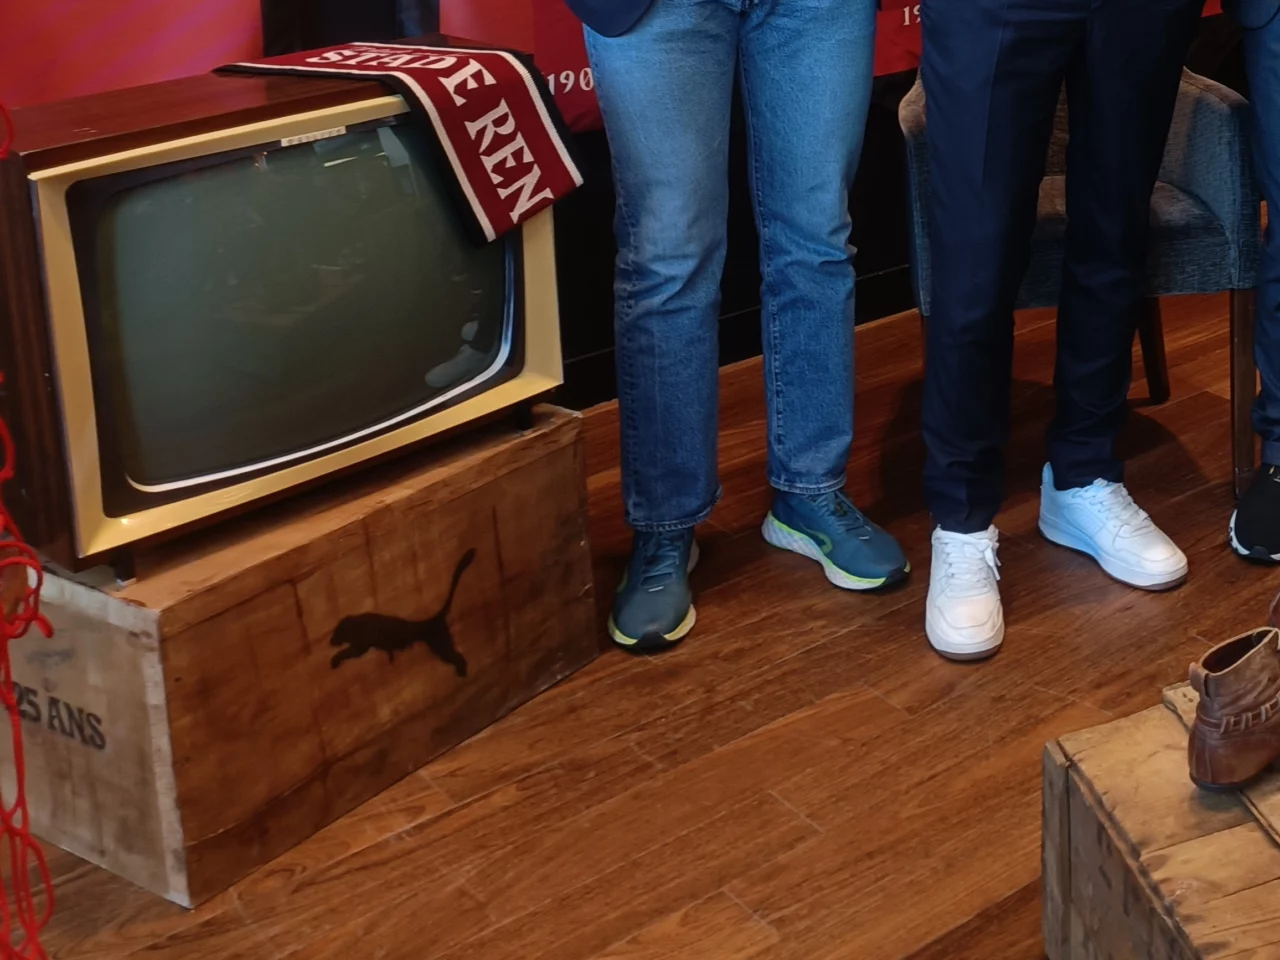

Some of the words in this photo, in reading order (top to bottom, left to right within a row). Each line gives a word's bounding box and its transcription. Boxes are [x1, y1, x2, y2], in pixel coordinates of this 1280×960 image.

[902, 4, 921, 26] 19
[547, 67, 594, 96] 190
[304, 49, 498, 107] STADE
[464, 97, 555, 225] REN
[47, 695, 107, 751] ANS
